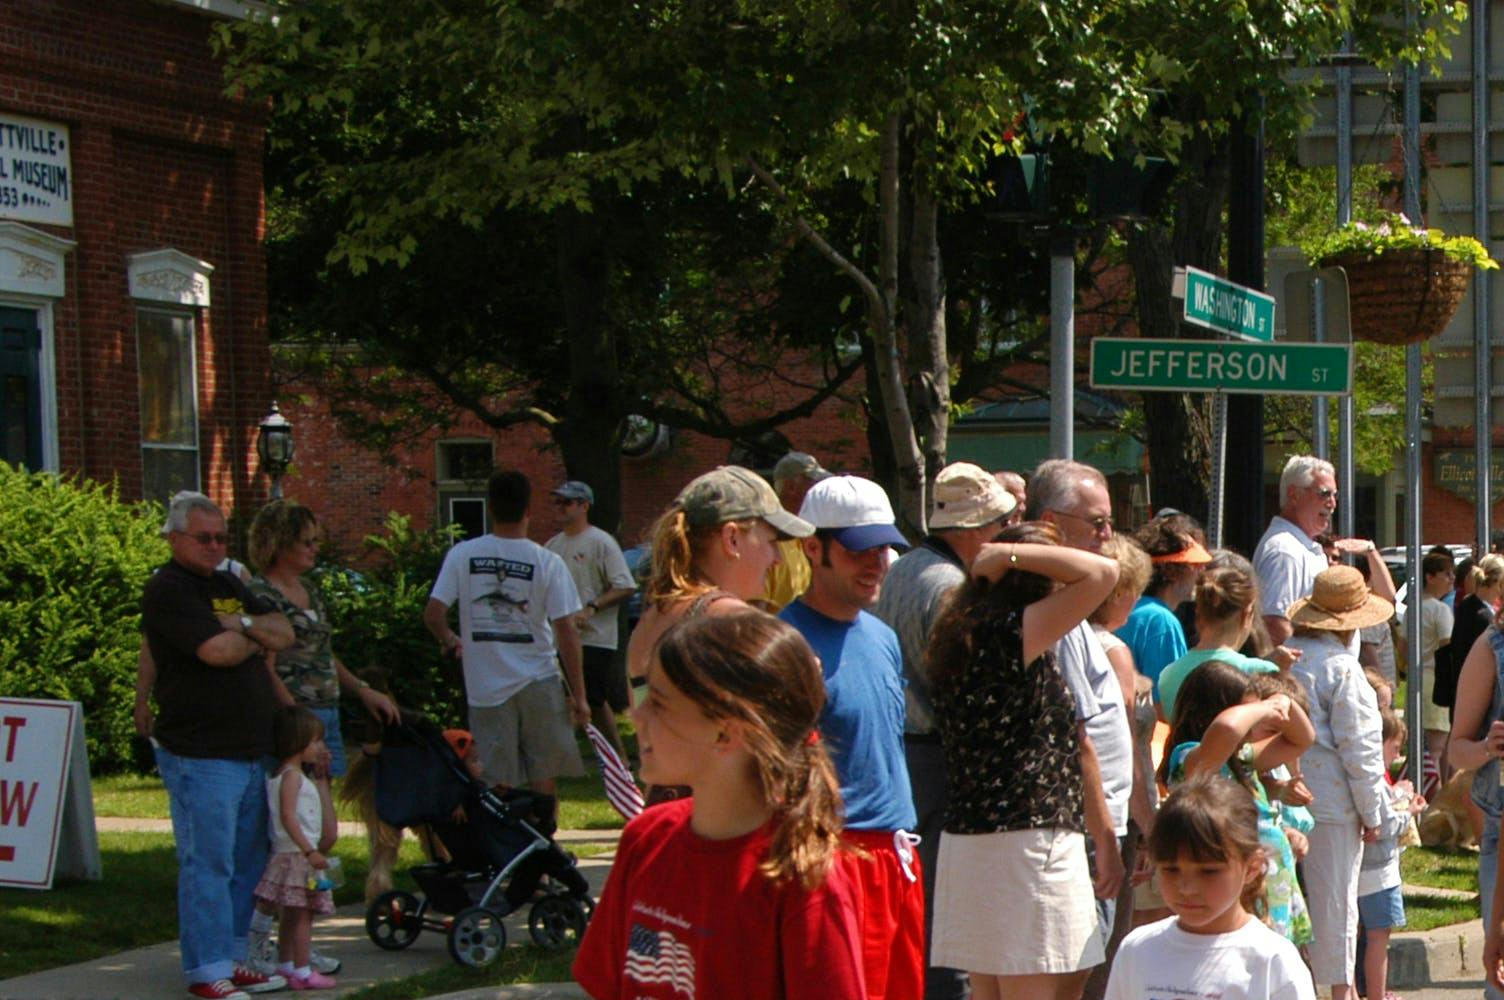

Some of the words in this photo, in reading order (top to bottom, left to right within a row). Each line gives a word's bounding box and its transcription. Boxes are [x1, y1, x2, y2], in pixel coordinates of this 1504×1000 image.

[0, 185, 18, 208] 53
[13, 158, 68, 201] MUSEUM
[1194, 281, 1256, 329] WASHINGTON
[1111, 349, 1286, 381] JEFFERSON
[1311, 367, 1329, 383] ST
